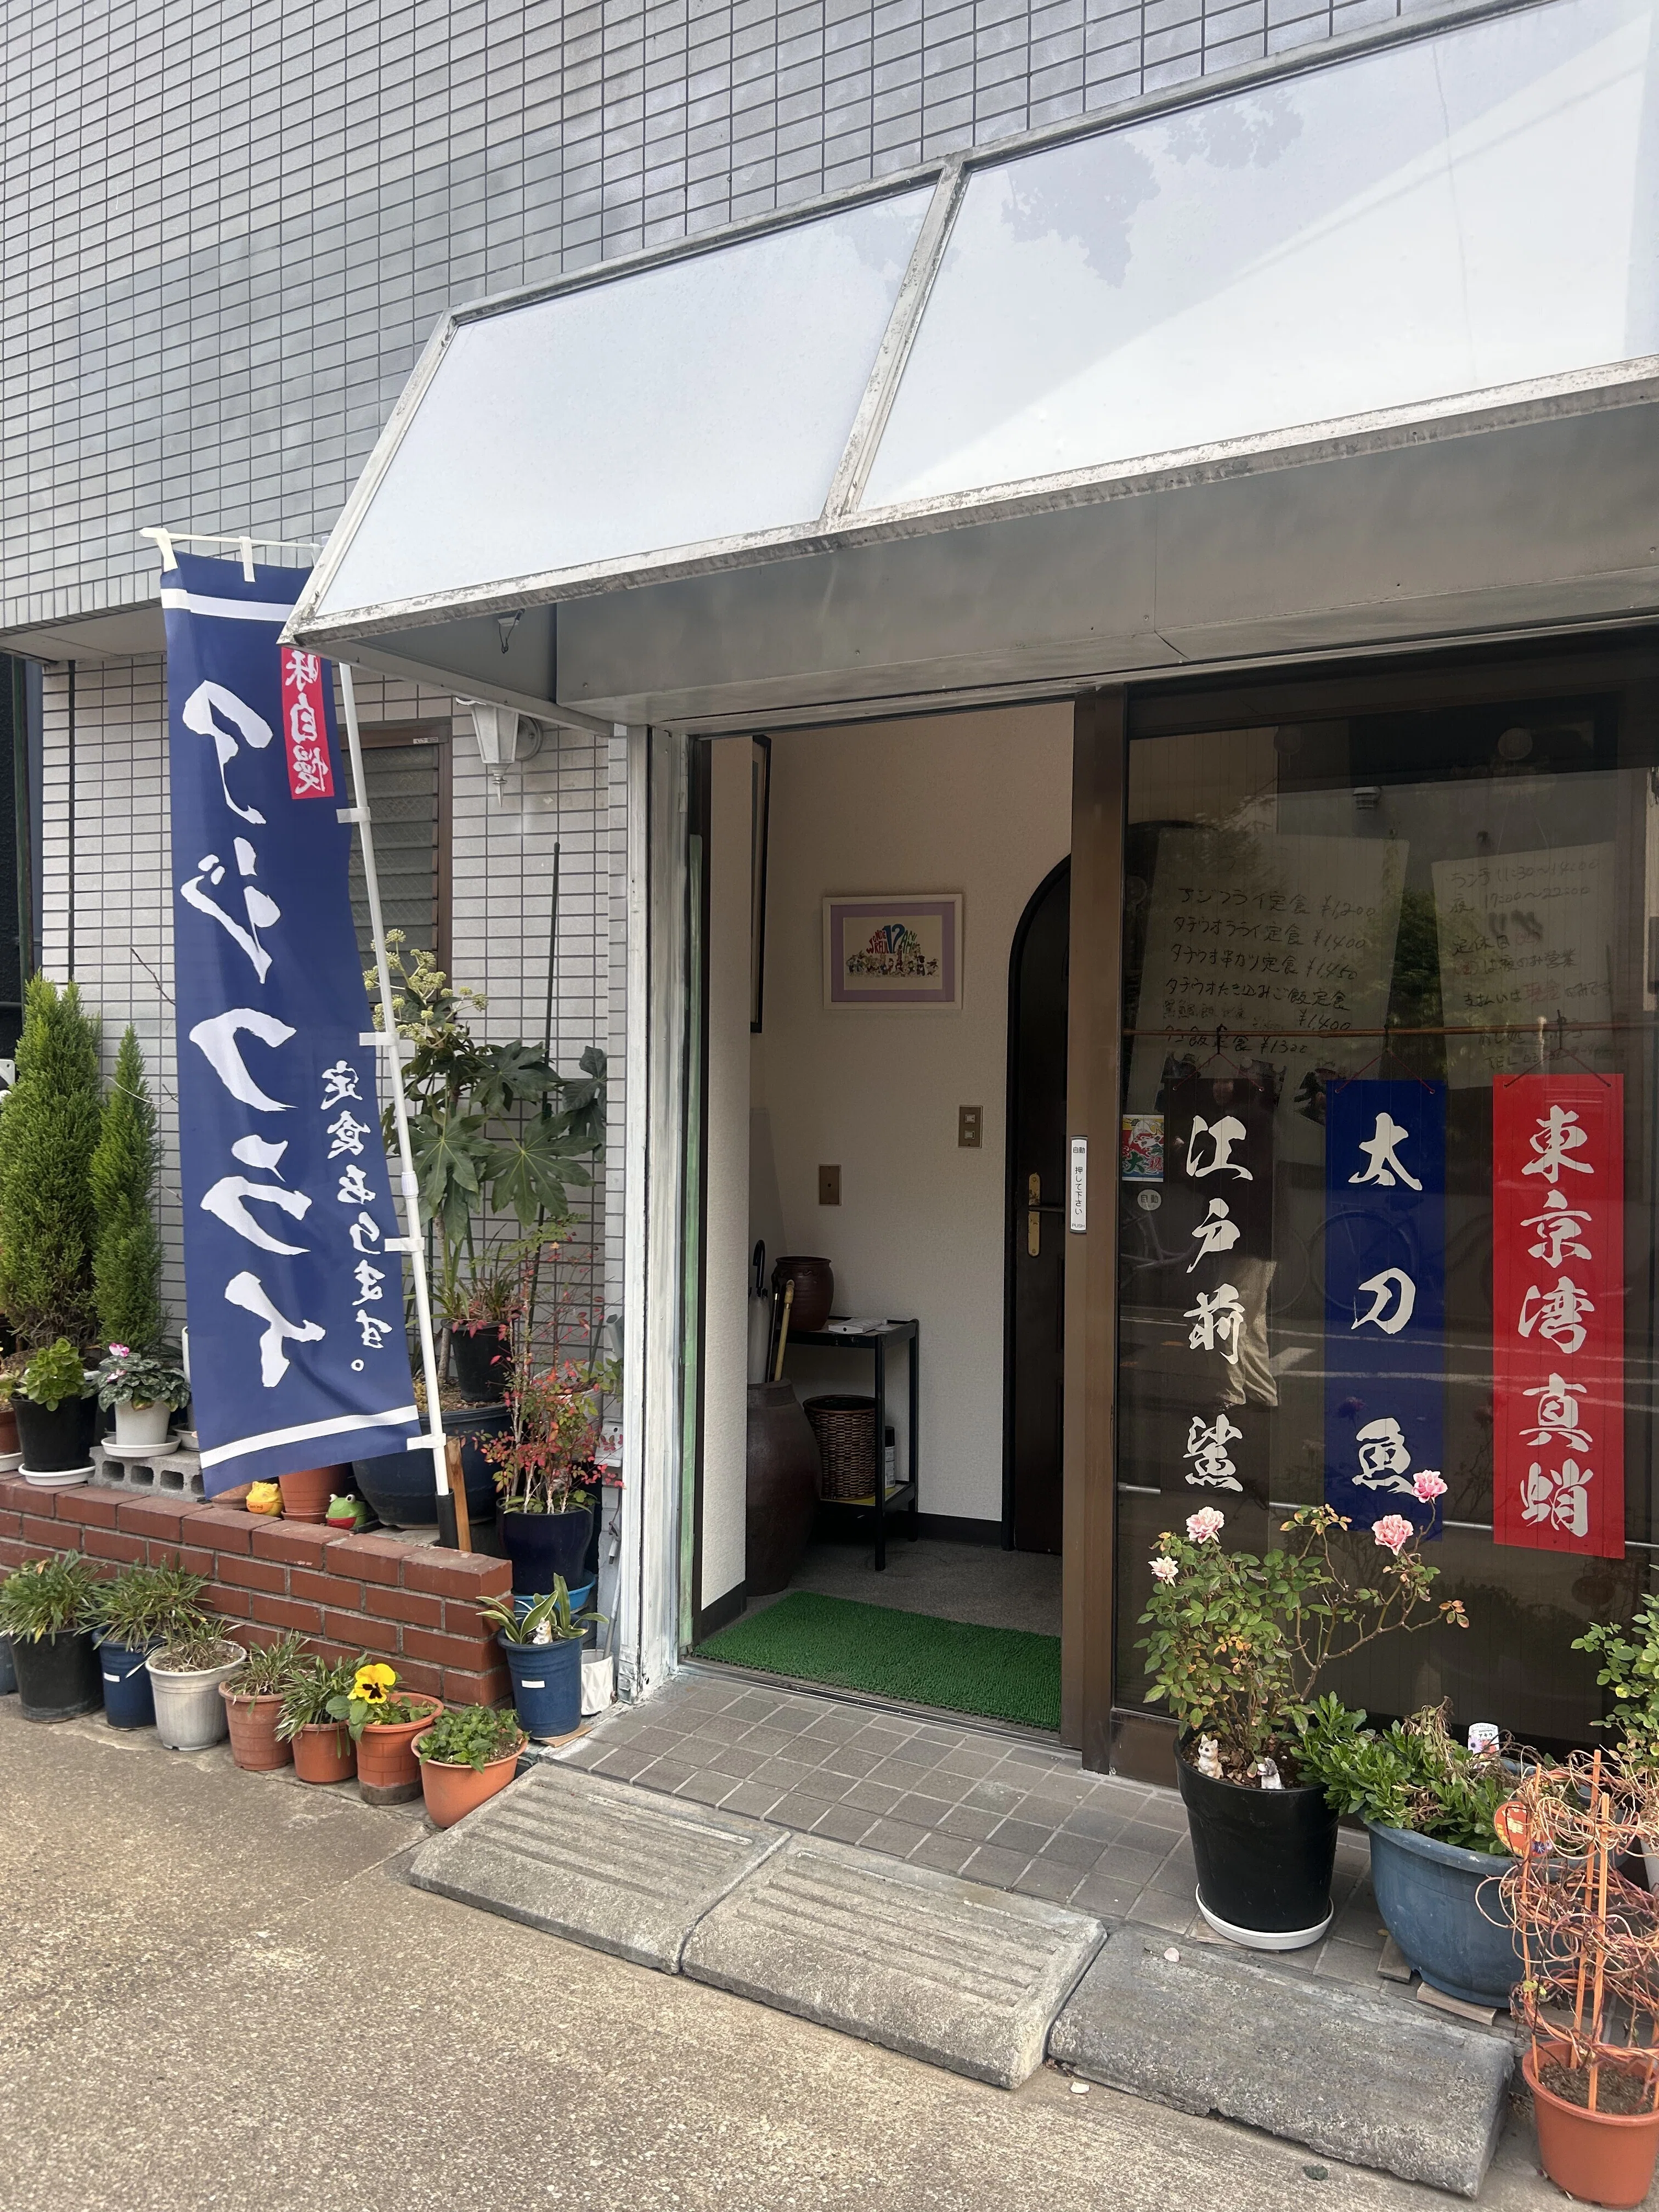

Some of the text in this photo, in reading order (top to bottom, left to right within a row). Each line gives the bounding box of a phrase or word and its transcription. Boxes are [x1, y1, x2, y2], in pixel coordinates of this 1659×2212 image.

[1178, 888, 1310, 915] アジフライ定食
[1075, 1166, 1083, 1215] 押して下さい
[1141, 1194, 1159, 1204] 自動
[1348, 1111, 1423, 1494] 太刀魚
[1517, 1104, 1595, 1537] 東京湾真蛸
